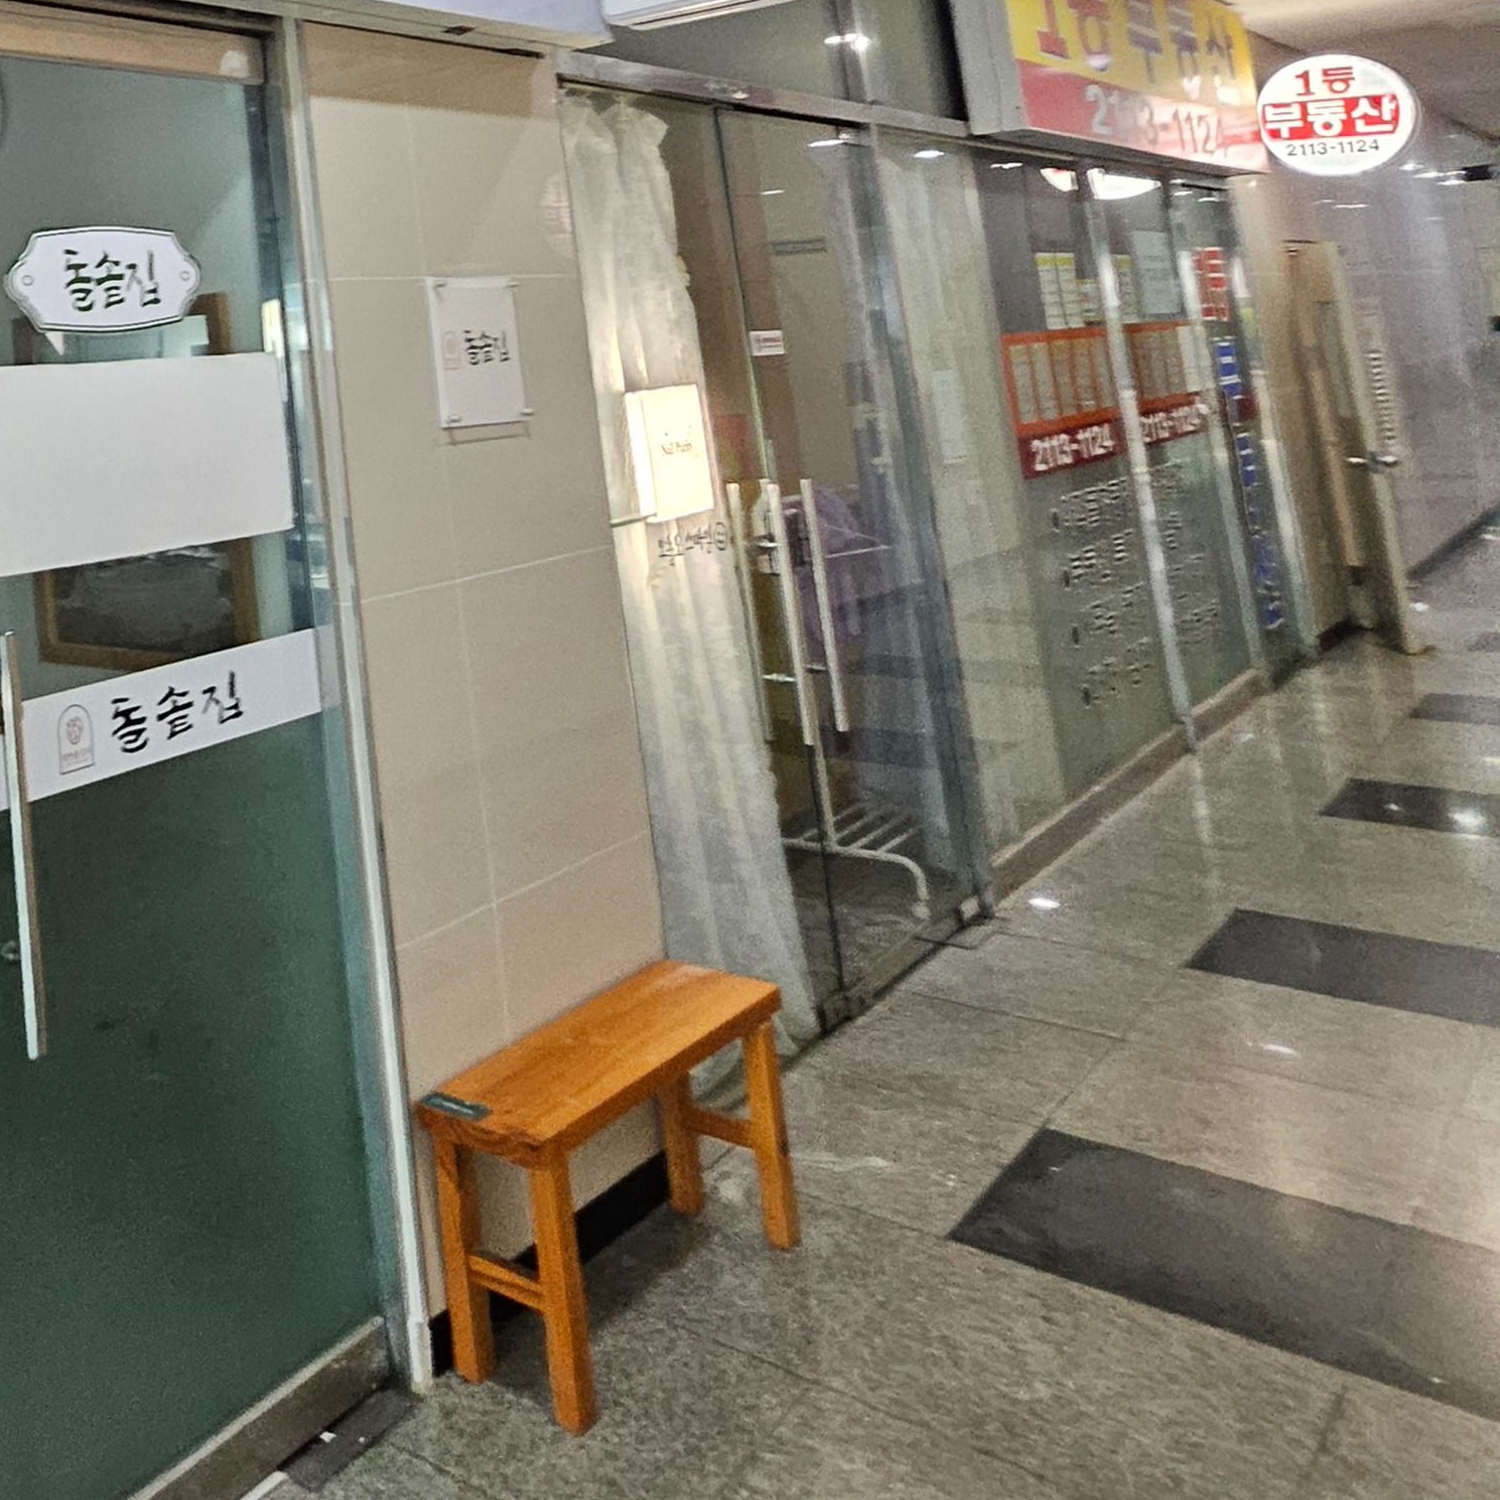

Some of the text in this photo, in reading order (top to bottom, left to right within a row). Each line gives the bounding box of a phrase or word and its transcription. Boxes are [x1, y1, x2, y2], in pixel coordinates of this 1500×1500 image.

[1294, 65, 1356, 97] 1등
[1264, 93, 1398, 140] 부동산
[1285, 138, 1380, 157] 2113-1124
